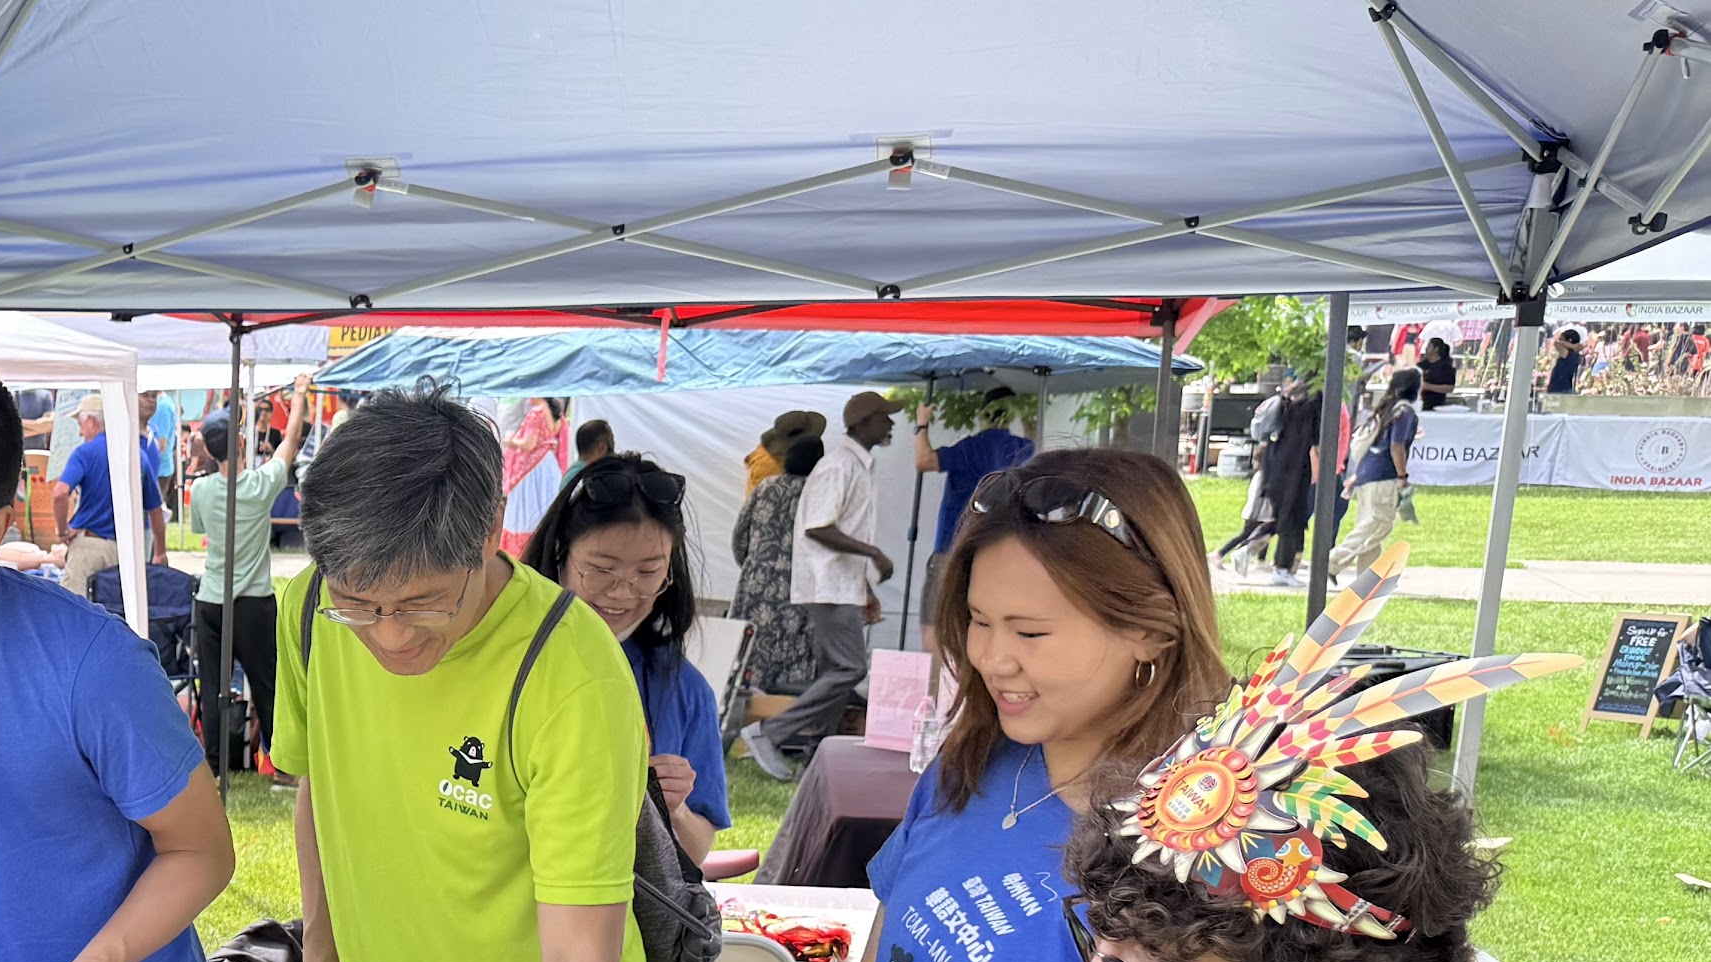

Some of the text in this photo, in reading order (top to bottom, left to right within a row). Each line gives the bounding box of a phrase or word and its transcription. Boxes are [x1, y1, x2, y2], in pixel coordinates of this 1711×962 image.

[1553, 304, 1617, 314] INDIA BAZAAR
[1637, 305, 1703, 315] INDIA BAZAAR
[1610, 475, 1702, 487] INDIA BAZAAR
[1630, 636, 1657, 646] FREE
[1175, 779, 1214, 815] TAIWAN
[438, 797, 489, 821] TAIWAN
[975, 893, 1016, 936] TAIWAN
